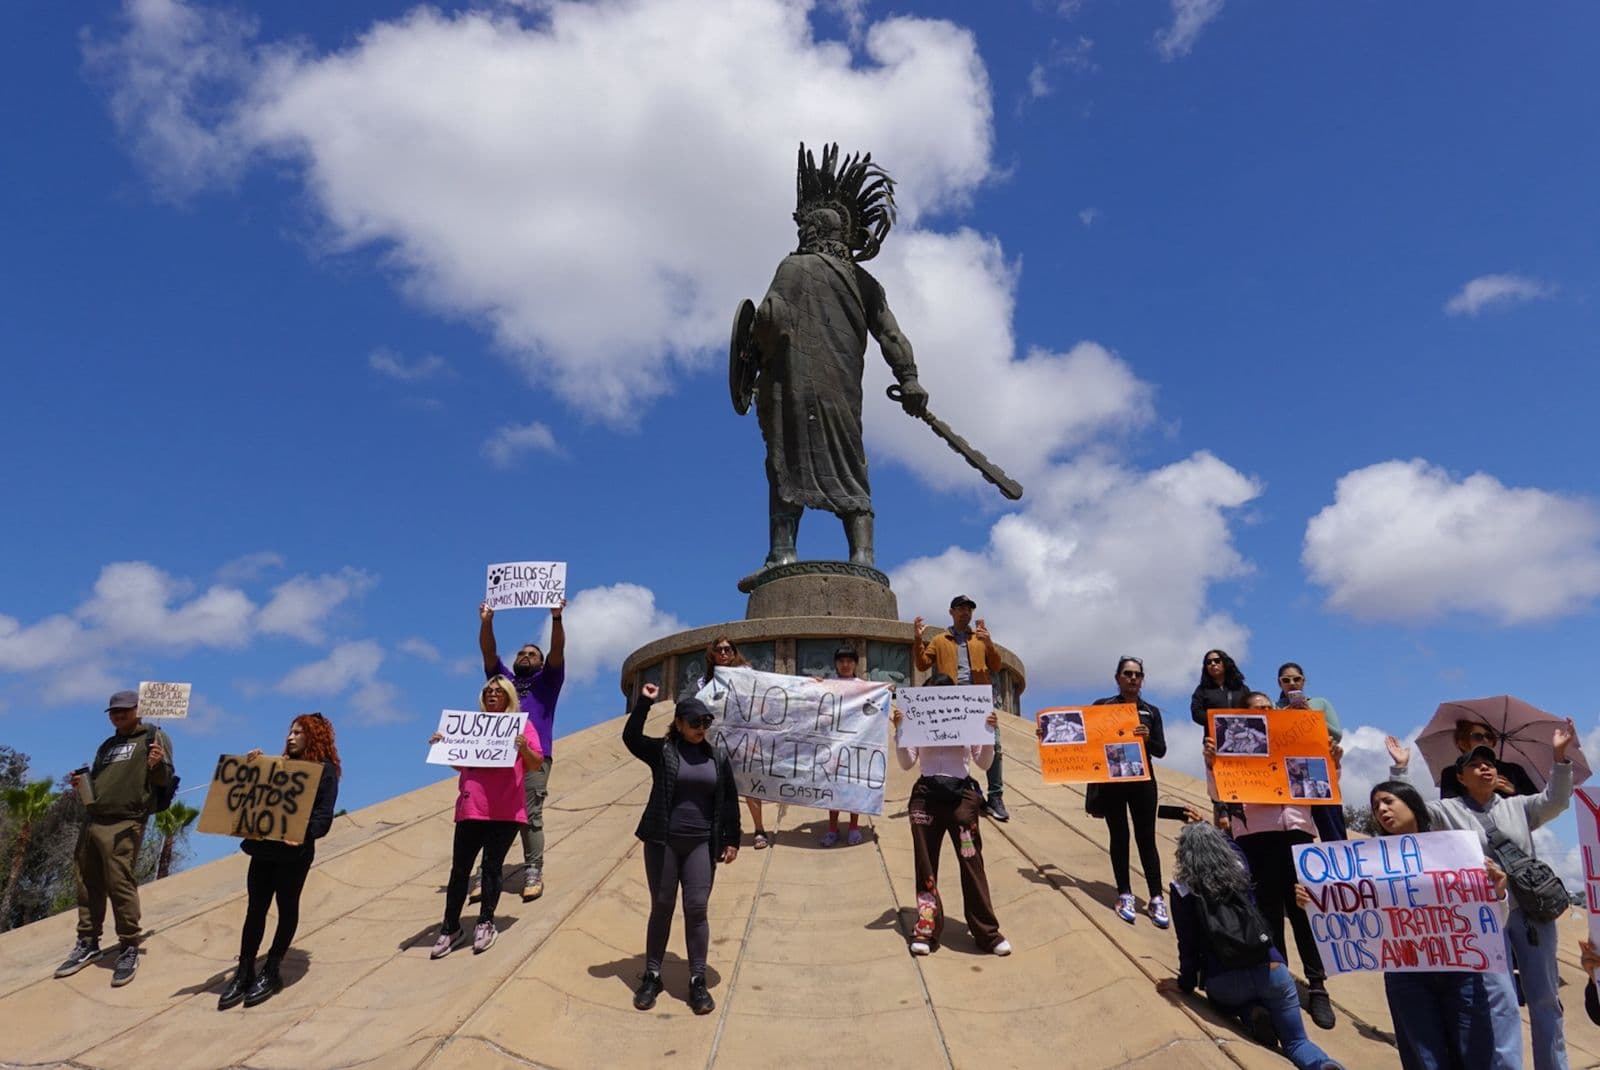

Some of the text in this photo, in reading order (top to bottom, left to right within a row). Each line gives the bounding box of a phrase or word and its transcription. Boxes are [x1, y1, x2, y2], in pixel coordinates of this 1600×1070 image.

[446, 713, 521, 738] JUSTICIA
[723, 678, 858, 734] NO AL
[448, 748, 508, 761] SU VOZ!
[715, 731, 887, 790] MALTRATO
[227, 784, 298, 815] GATOS
[780, 783, 834, 801] BASTA
[1299, 835, 1424, 883] QUE LA
[1304, 868, 1498, 913] VIDA TE TRATE
[1311, 904, 1499, 943] COMO TRATAS A
[1331, 933, 1490, 972] LOS ANIMALES
